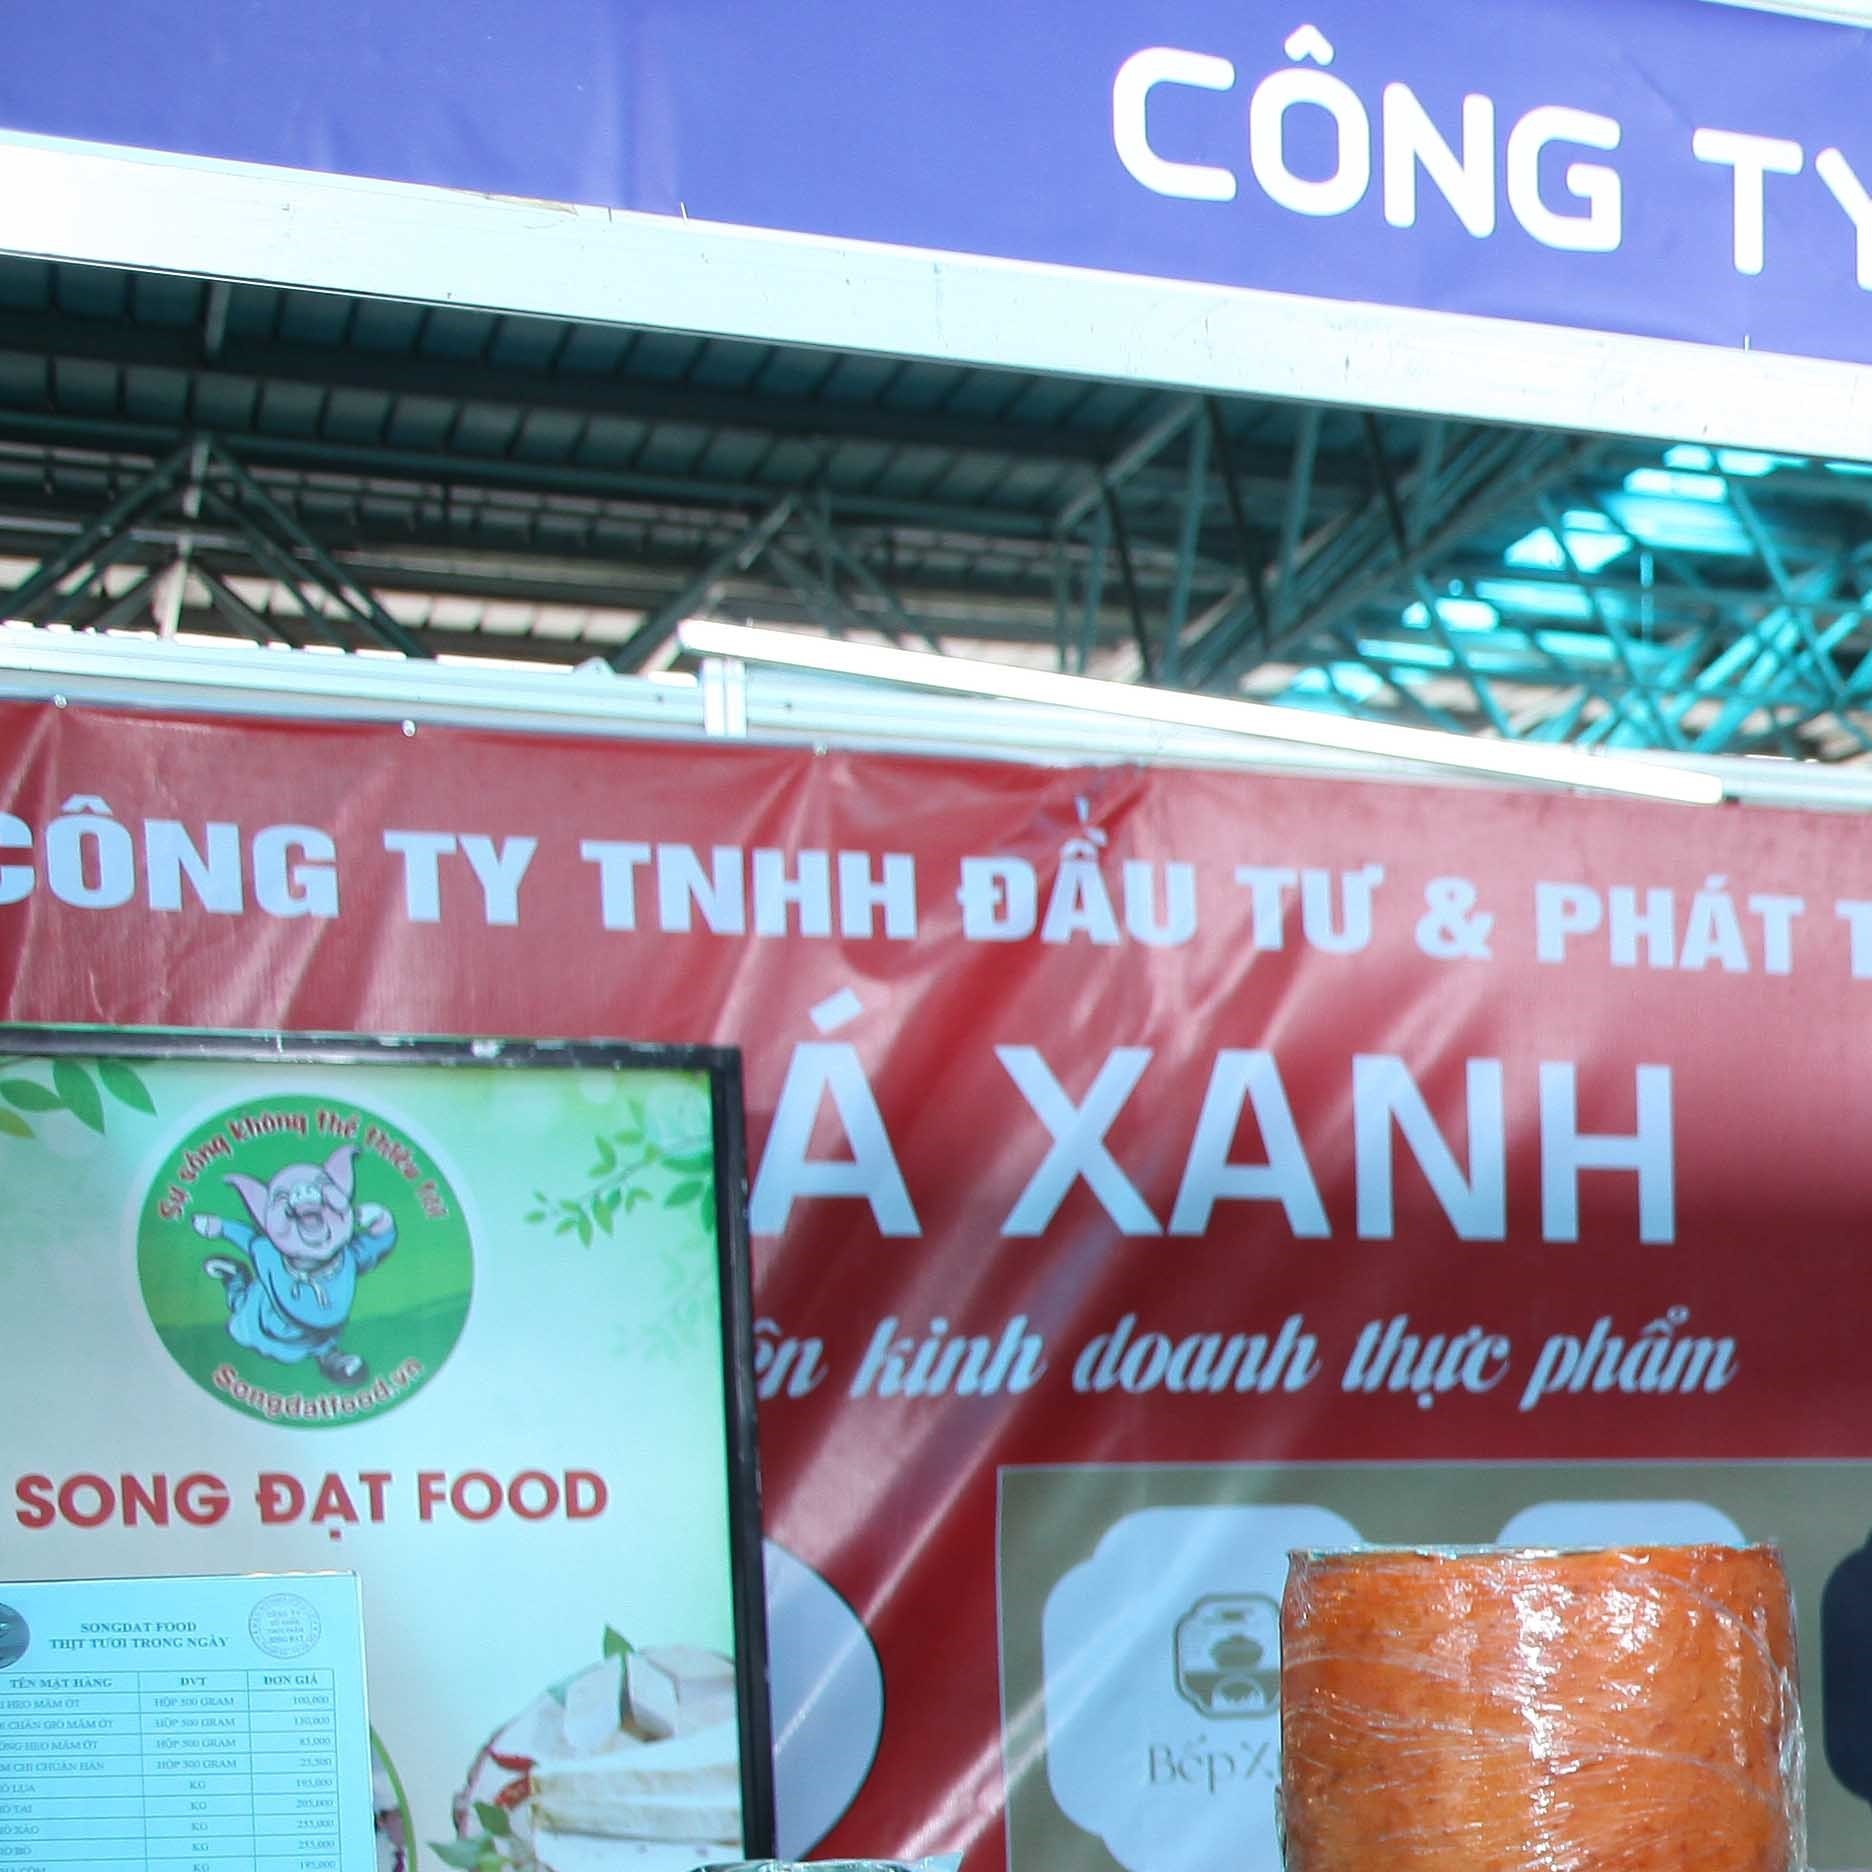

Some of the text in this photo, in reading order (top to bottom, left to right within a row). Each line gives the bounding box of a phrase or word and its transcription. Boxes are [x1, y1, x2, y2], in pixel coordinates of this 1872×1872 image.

[1112, 24, 1621, 252] CÔNG
[383, 829, 538, 927] TY
[581, 839, 917, 941] TNHH
[959, 797, 1196, 947] ĐẦU
[1236, 865, 1381, 953] TƯ
[1414, 875, 1523, 961] &
[1535, 876, 1804, 975] PHÁT
[992, 1044, 1674, 1246] XANH
[850, 1314, 1047, 1400] kinh
[1073, 1312, 1323, 1398] doanh
[1342, 1312, 1508, 1410] thực
[1521, 1304, 1737, 1412] phẩm
[15, 1469, 609, 1540] SONG ĐẠT FOOD
[132, 1637, 183, 1648] TRONG
[156, 1621, 197, 1632] FOOD
